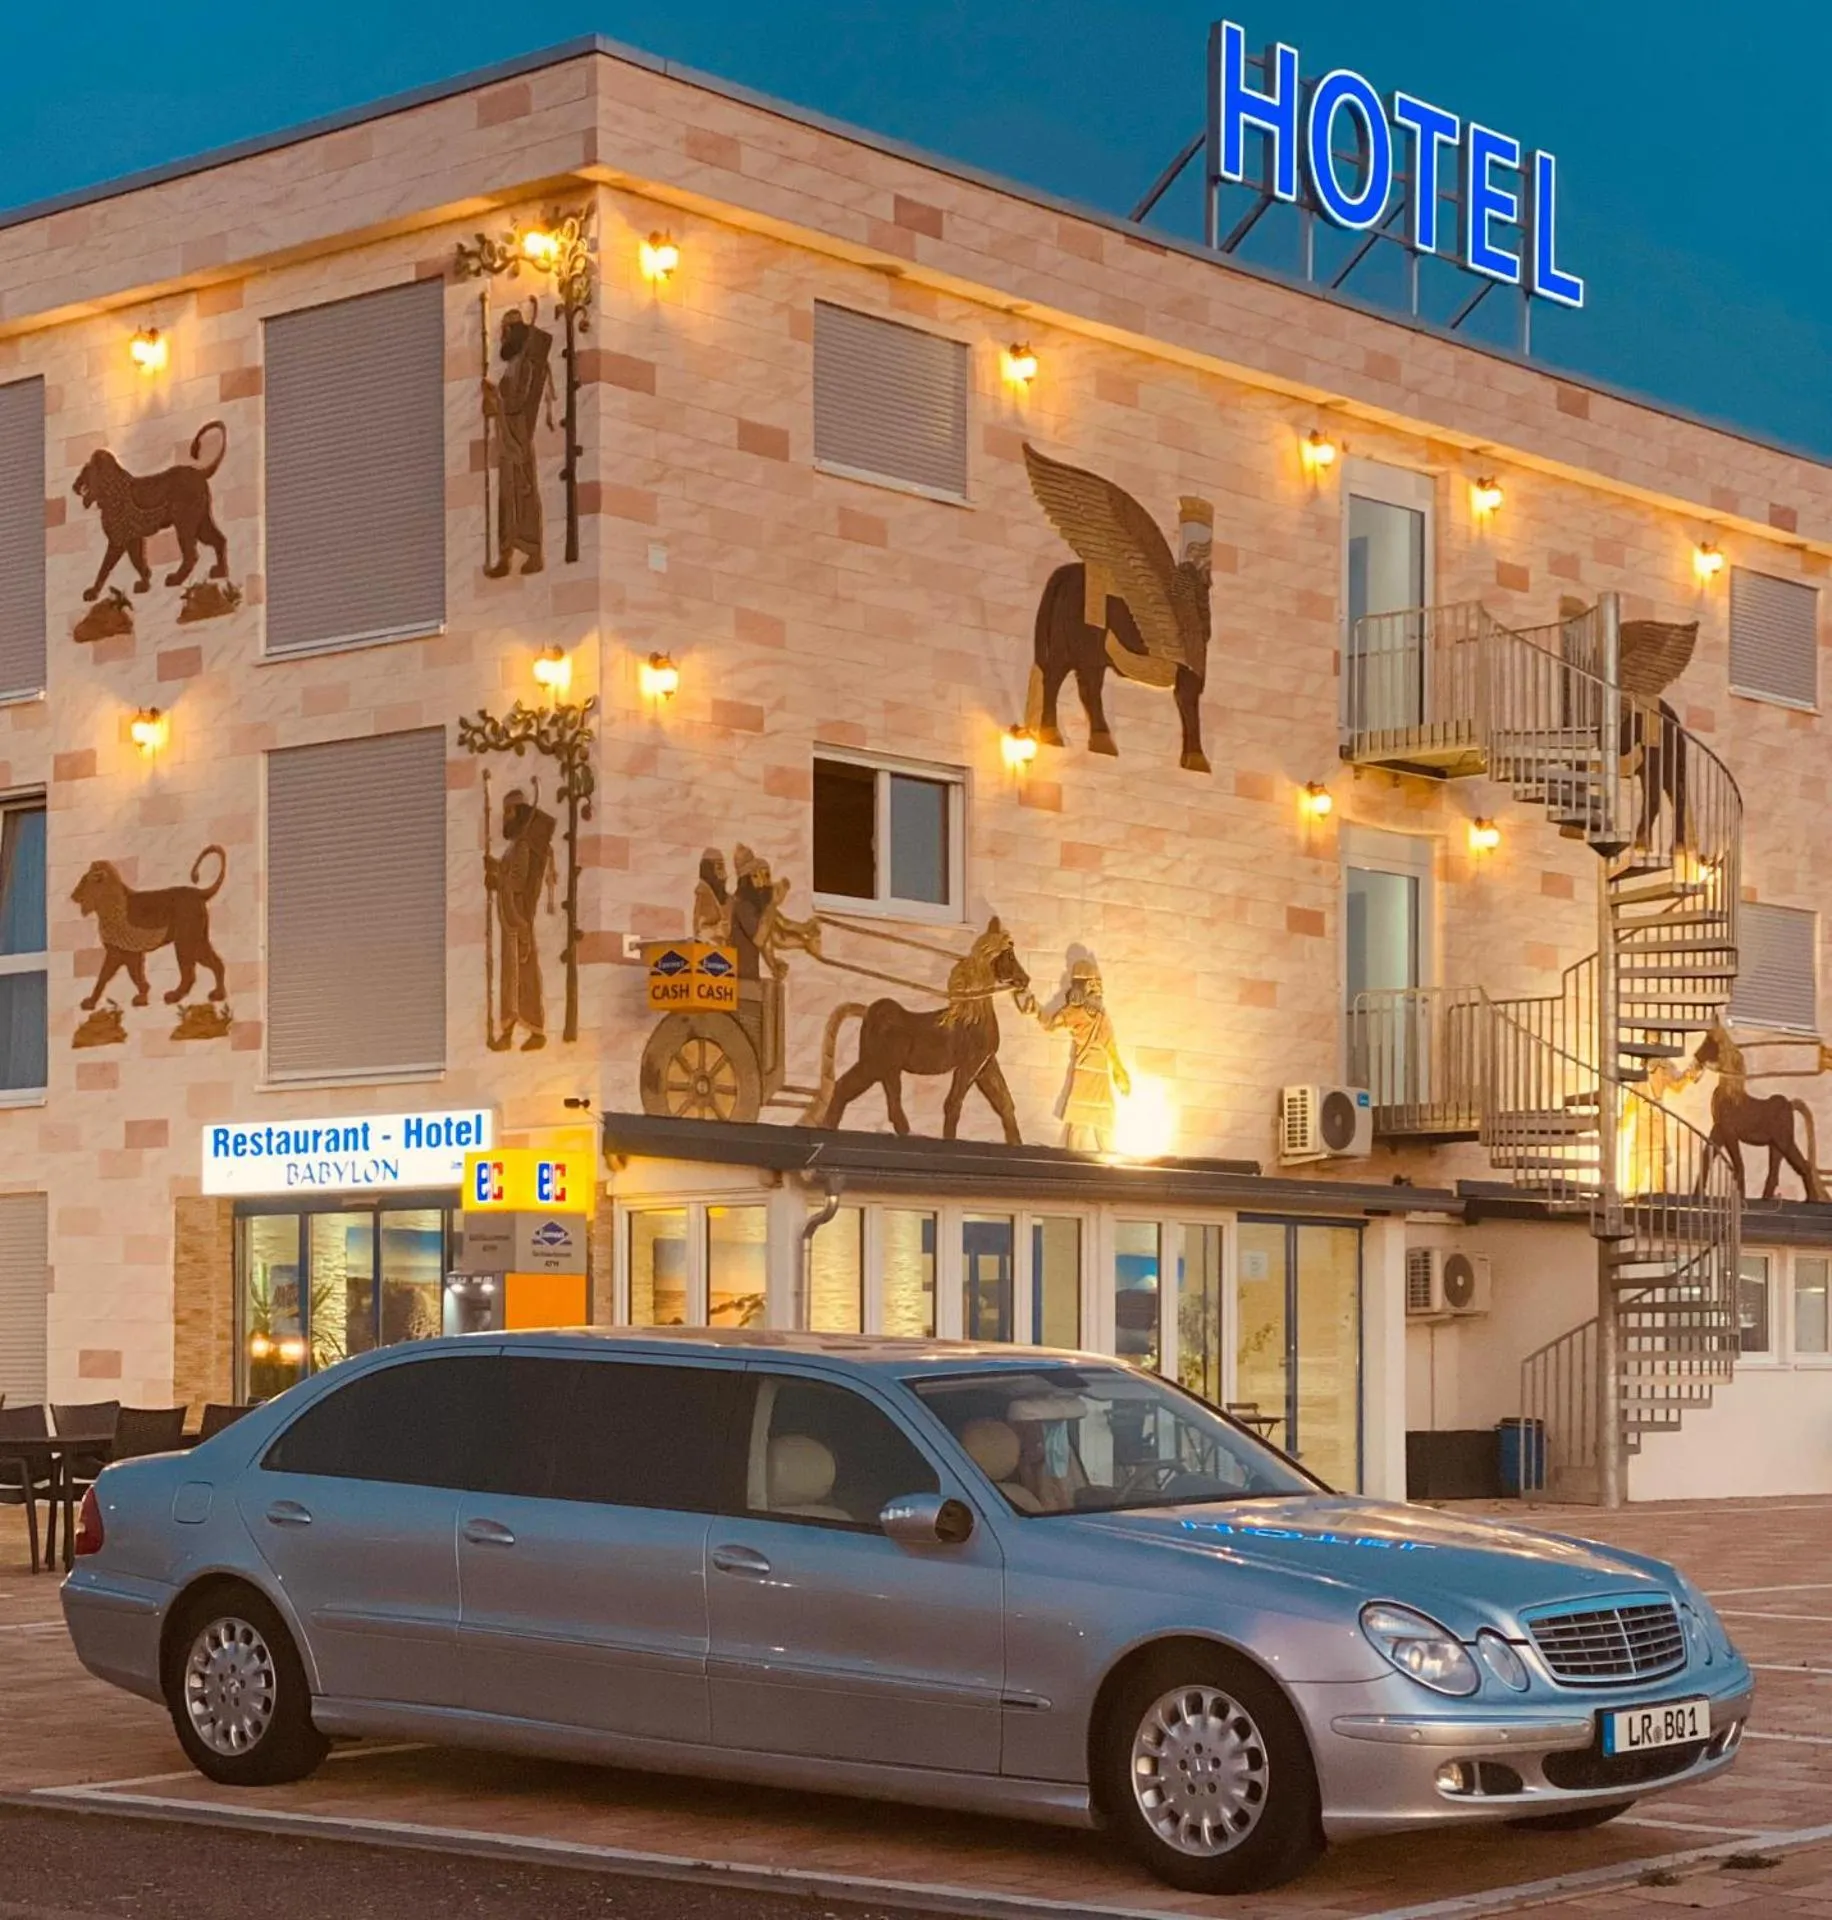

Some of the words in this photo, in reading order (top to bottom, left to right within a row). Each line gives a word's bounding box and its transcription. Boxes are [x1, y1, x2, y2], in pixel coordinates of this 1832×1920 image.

[1219, 18, 1585, 309] HOTEL
[651, 983, 690, 1001] CASH
[697, 983, 734, 1002] CASH
[212, 1121, 370, 1158] Restaurant
[404, 1113, 483, 1149] Hotel
[286, 1157, 399, 1186] BABYLON
[1628, 1713, 1653, 1747] LR
